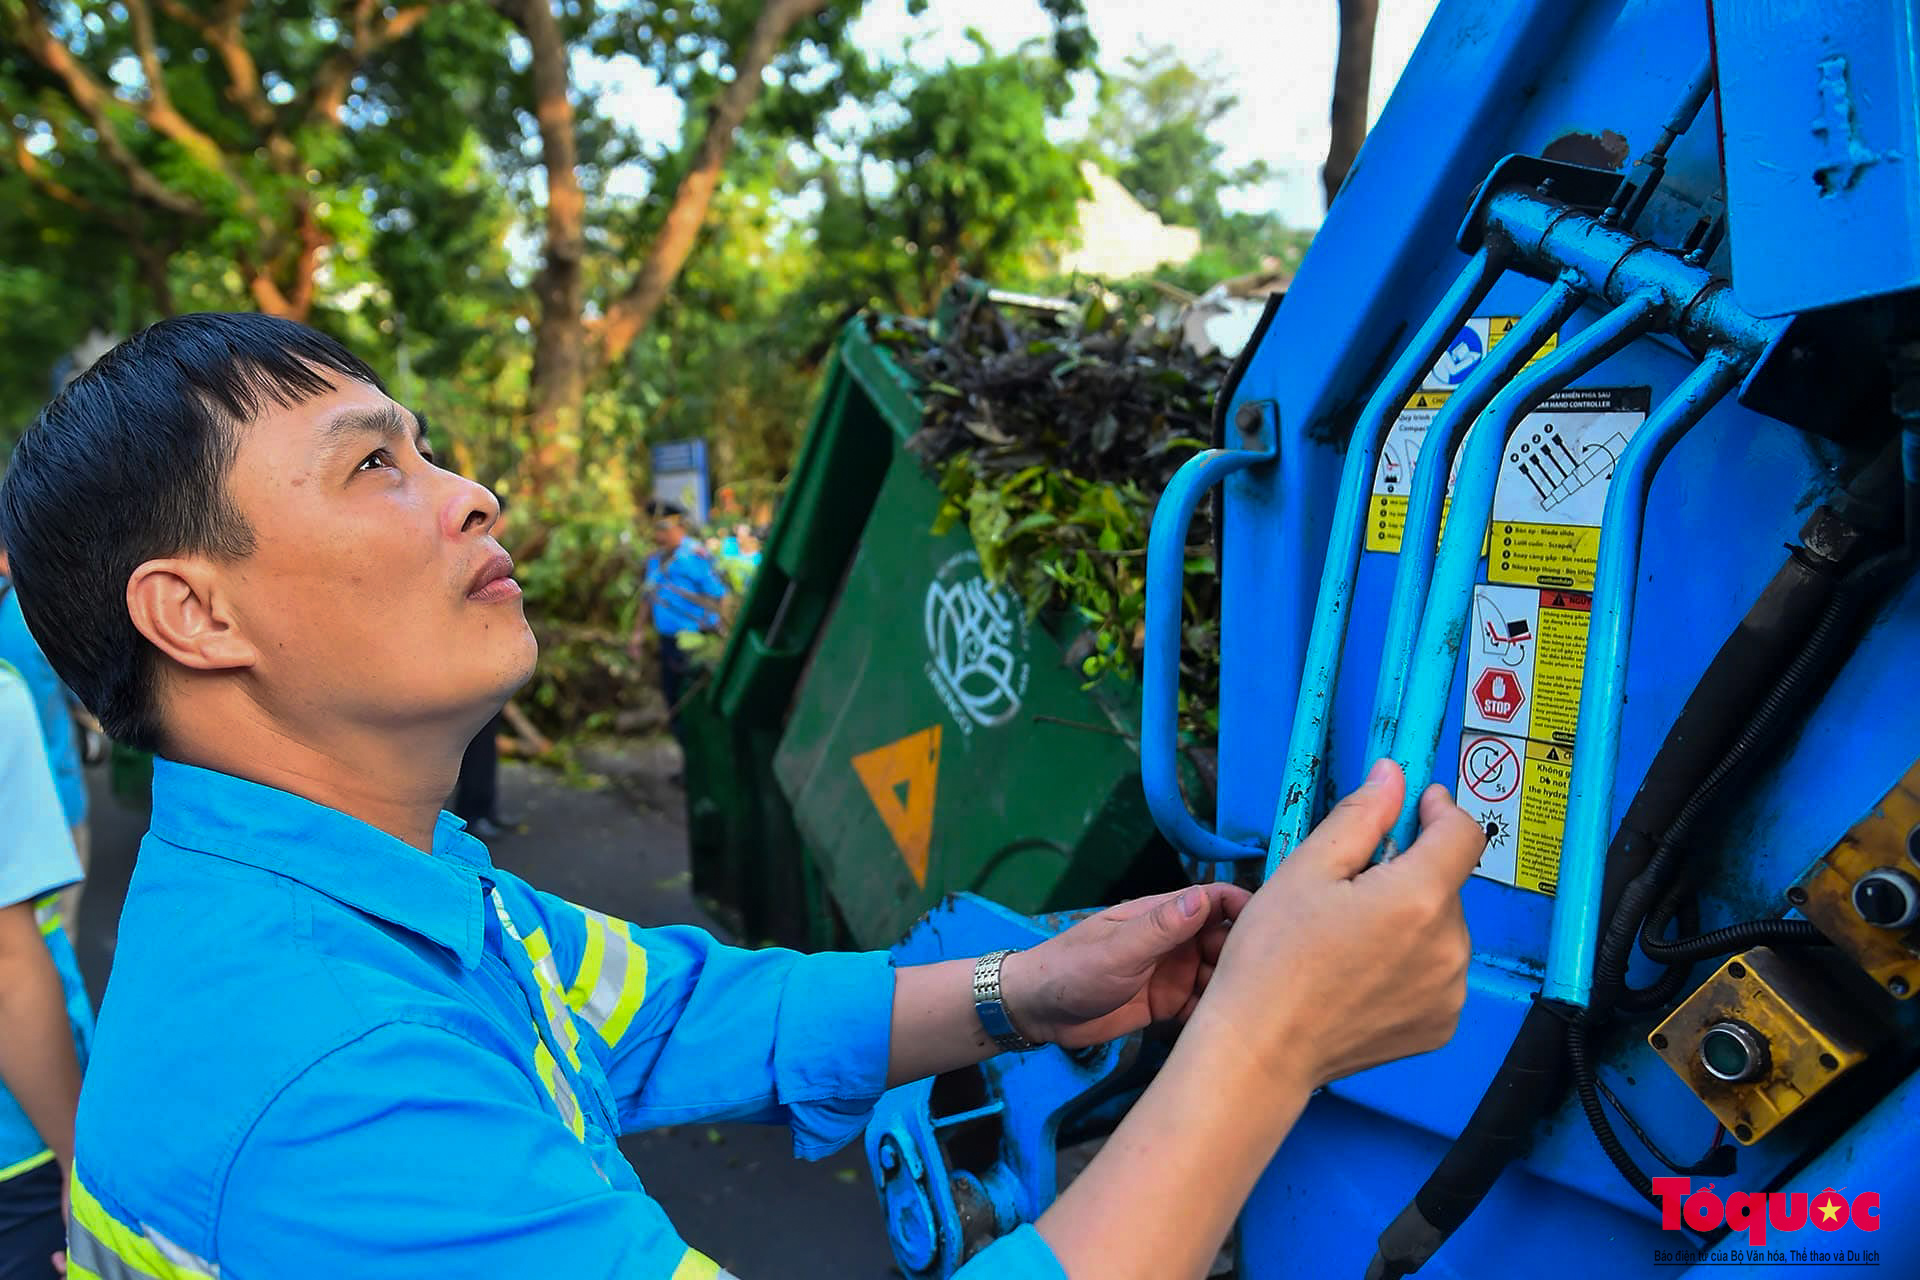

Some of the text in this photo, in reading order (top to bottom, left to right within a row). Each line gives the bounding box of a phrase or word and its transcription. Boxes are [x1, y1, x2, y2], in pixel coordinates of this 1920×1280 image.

[1598, 392, 1611, 400] SAU
[1484, 699, 1511, 715] STOP
[1537, 764, 1564, 777] Không
[1496, 784, 1506, 793] 5s
[1553, 779, 1566, 788] not
[1528, 786, 1568, 799] the hydra
